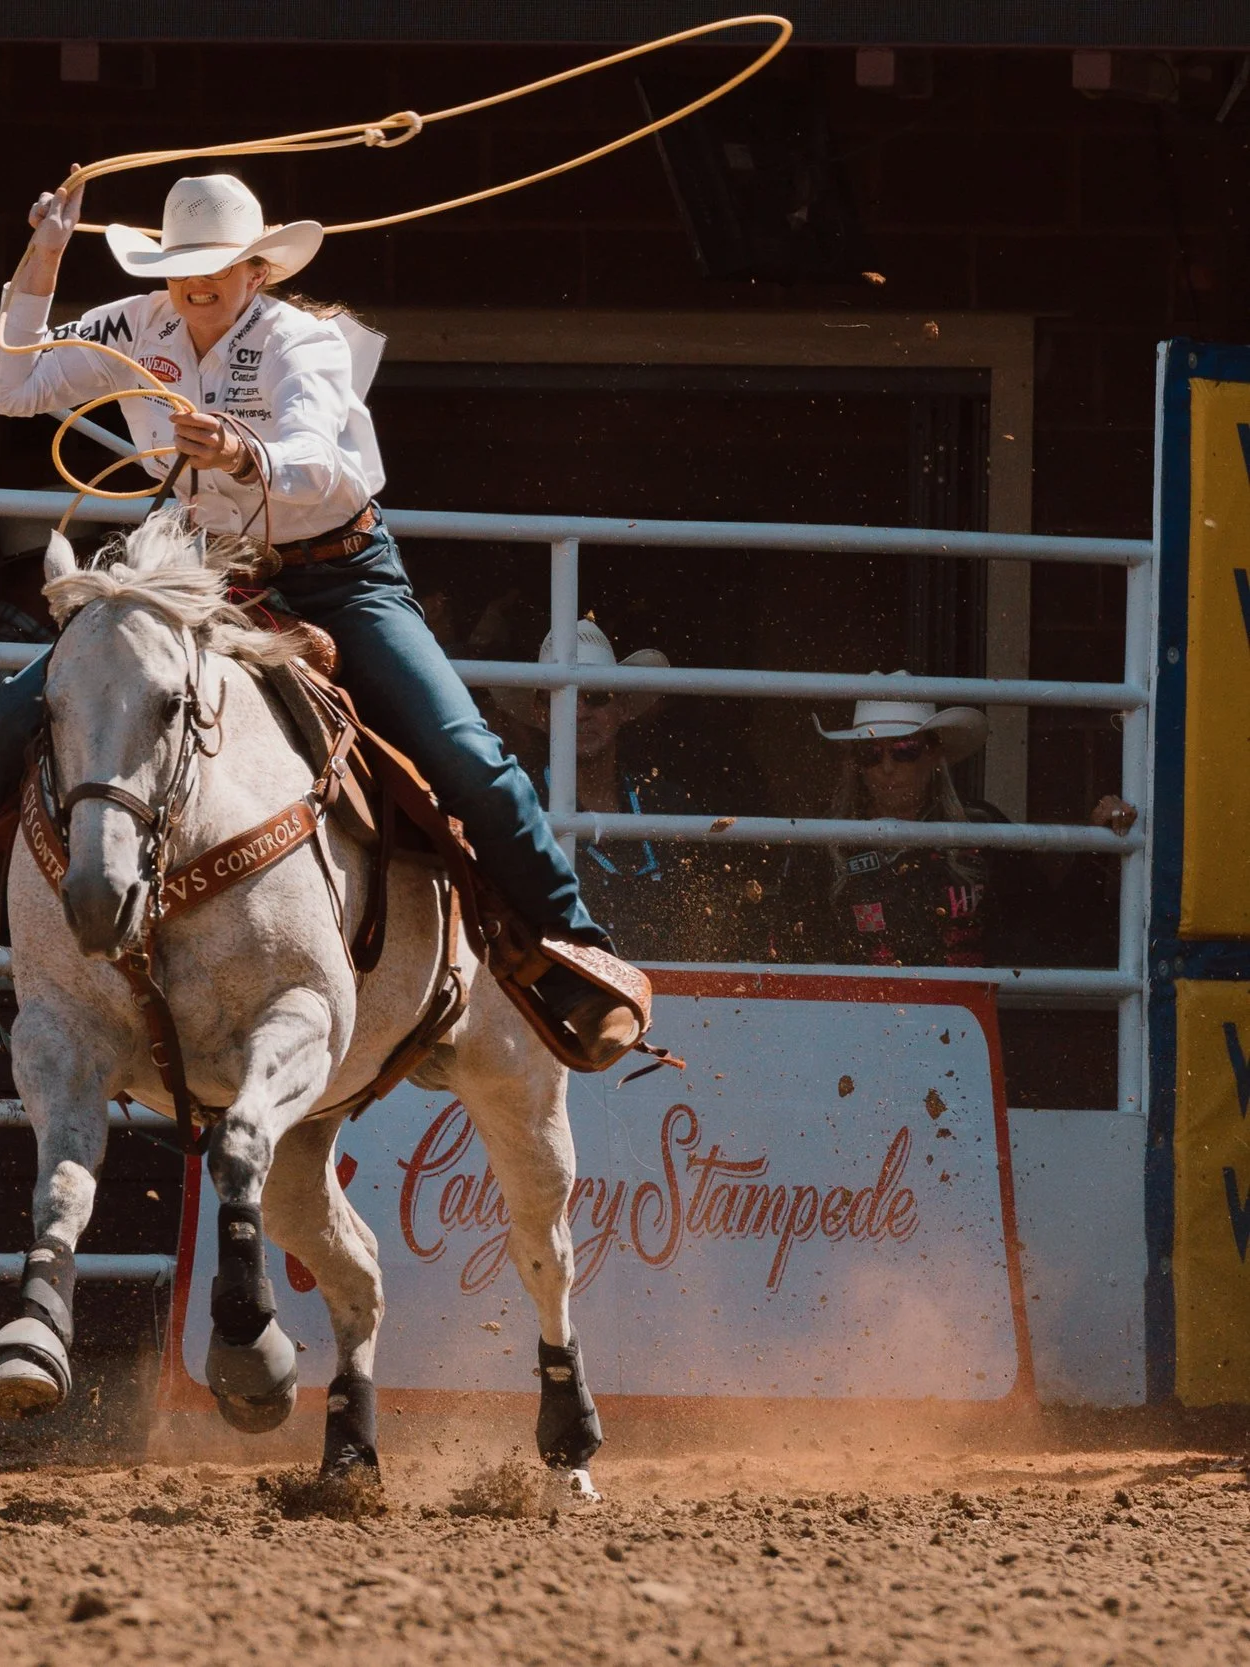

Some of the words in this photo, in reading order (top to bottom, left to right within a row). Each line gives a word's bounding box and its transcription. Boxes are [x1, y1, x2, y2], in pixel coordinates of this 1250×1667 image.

[342, 535, 362, 556] KP
[31, 821, 65, 881] CONTR
[165, 867, 208, 900] VS
[213, 812, 302, 877] CONTROLS
[848, 855, 877, 873] ETI
[629, 1103, 920, 1294] Stampede
